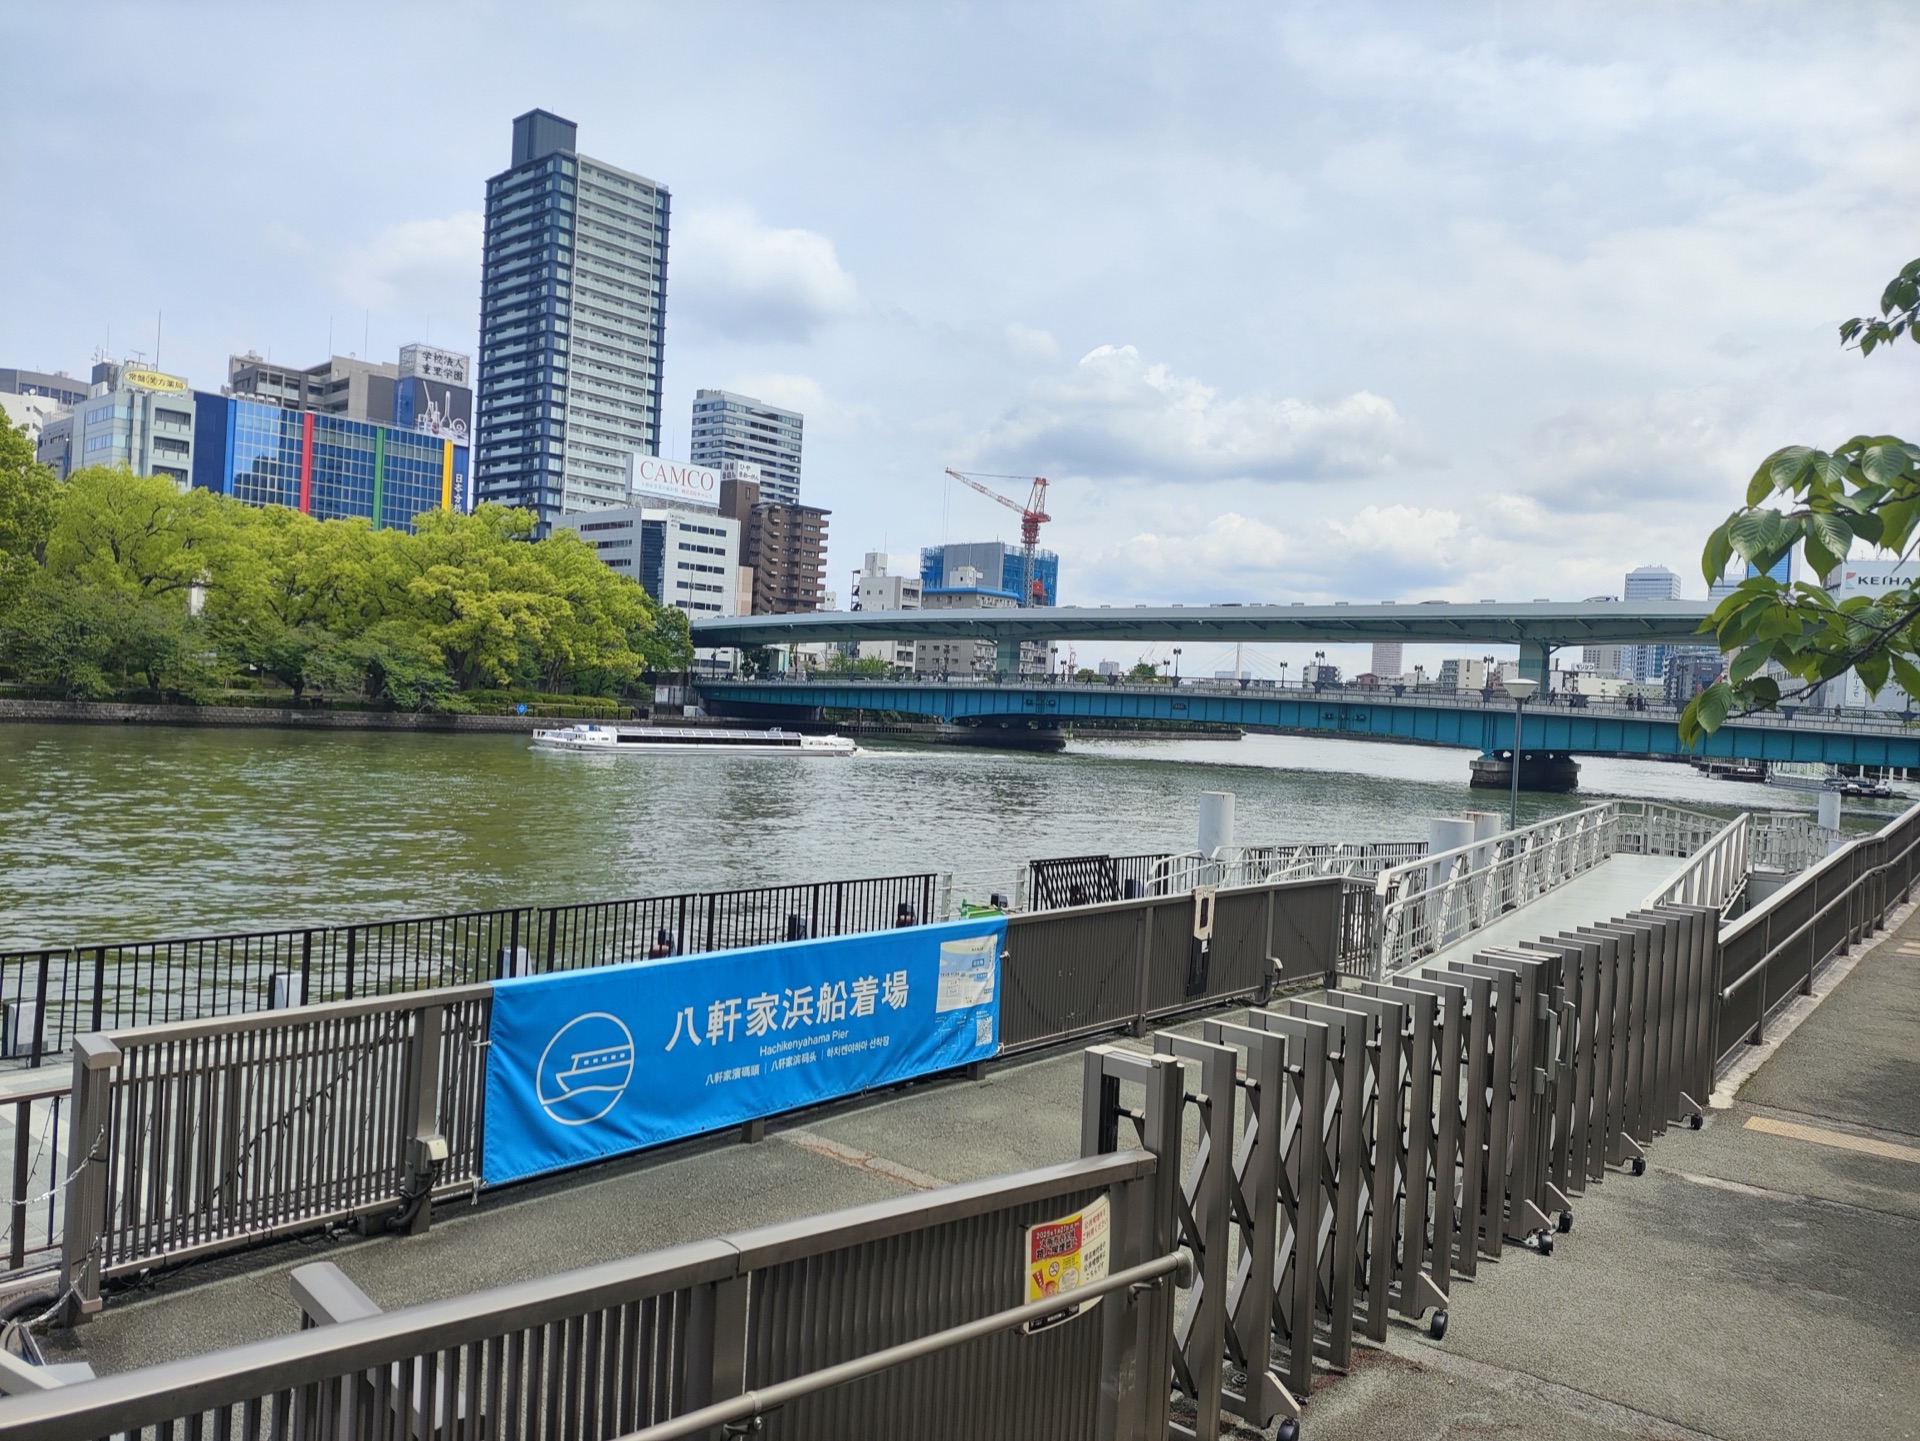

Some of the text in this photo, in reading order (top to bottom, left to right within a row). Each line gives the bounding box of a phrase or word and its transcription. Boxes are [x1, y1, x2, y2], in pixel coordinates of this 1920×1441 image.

[422, 350, 464, 369] 学校法人
[422, 363, 463, 382] 重里学園
[640, 460, 714, 491] CAMCO
[1858, 575, 1913, 586] KEIHA
[664, 969, 910, 1053] 八軒家浜船着場
[759, 1029, 849, 1057] Hachikenyahama Pier
[869, 1035, 890, 1050] 선착장
